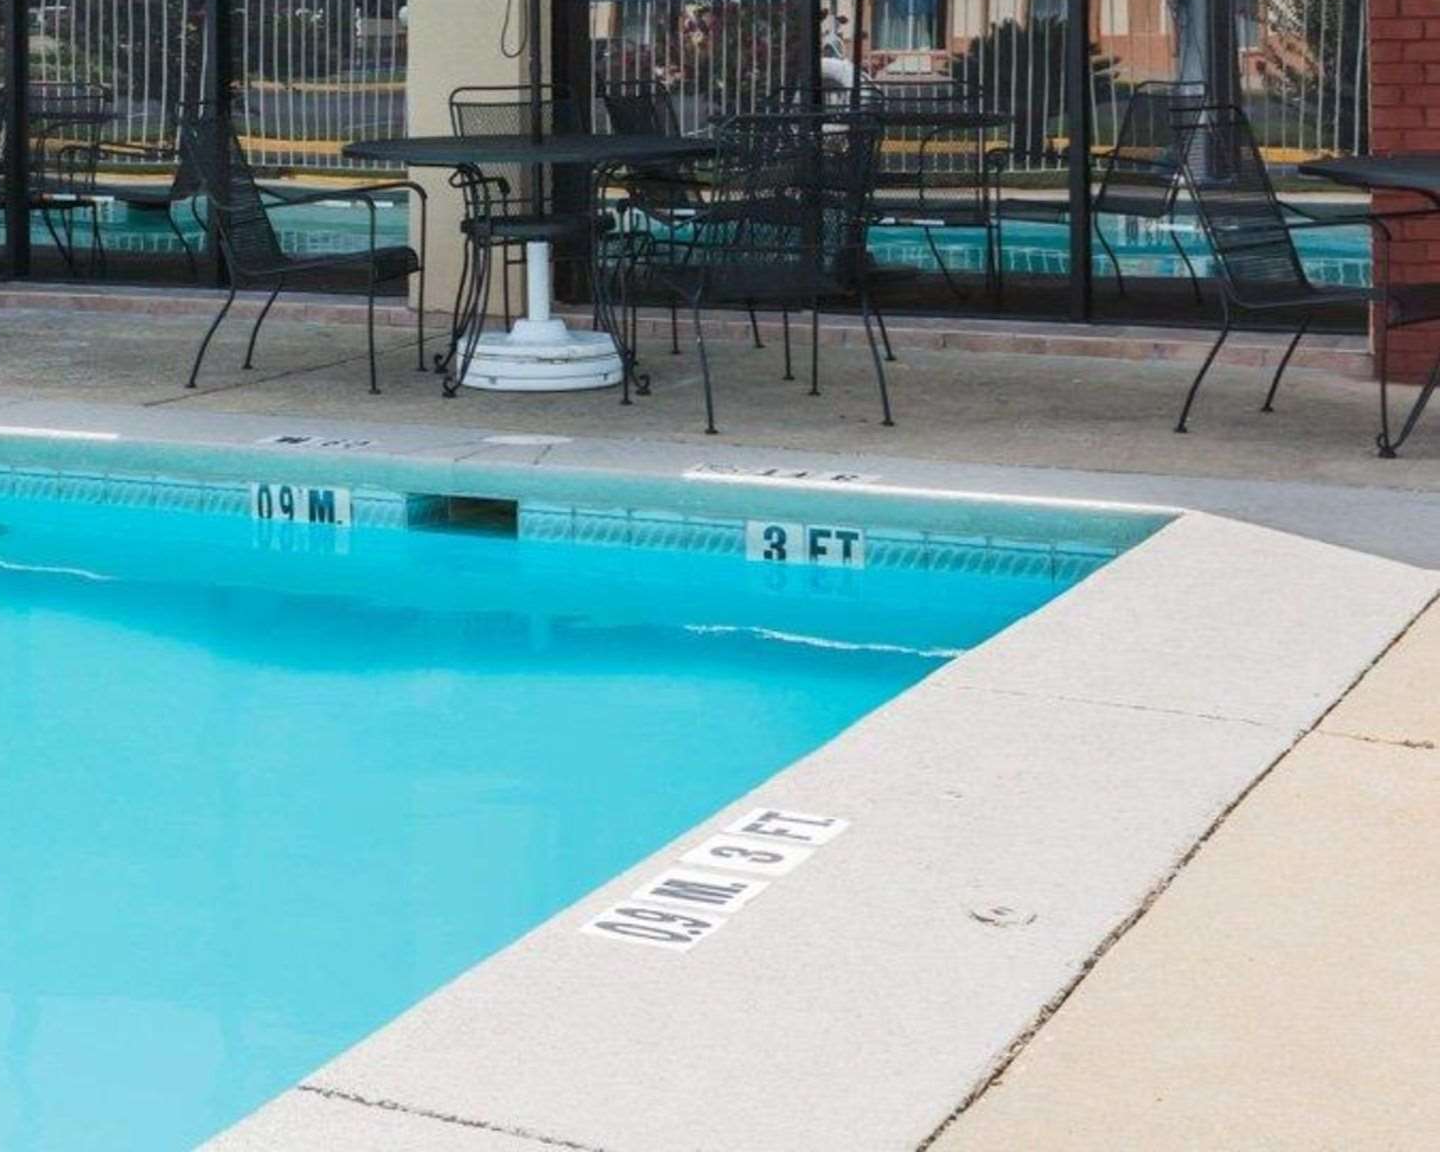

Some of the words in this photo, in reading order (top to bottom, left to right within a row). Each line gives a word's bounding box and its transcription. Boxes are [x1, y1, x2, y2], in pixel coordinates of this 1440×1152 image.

[763, 526, 786, 561] 3
[808, 529, 859, 564] FT
[710, 845, 784, 864] 3
